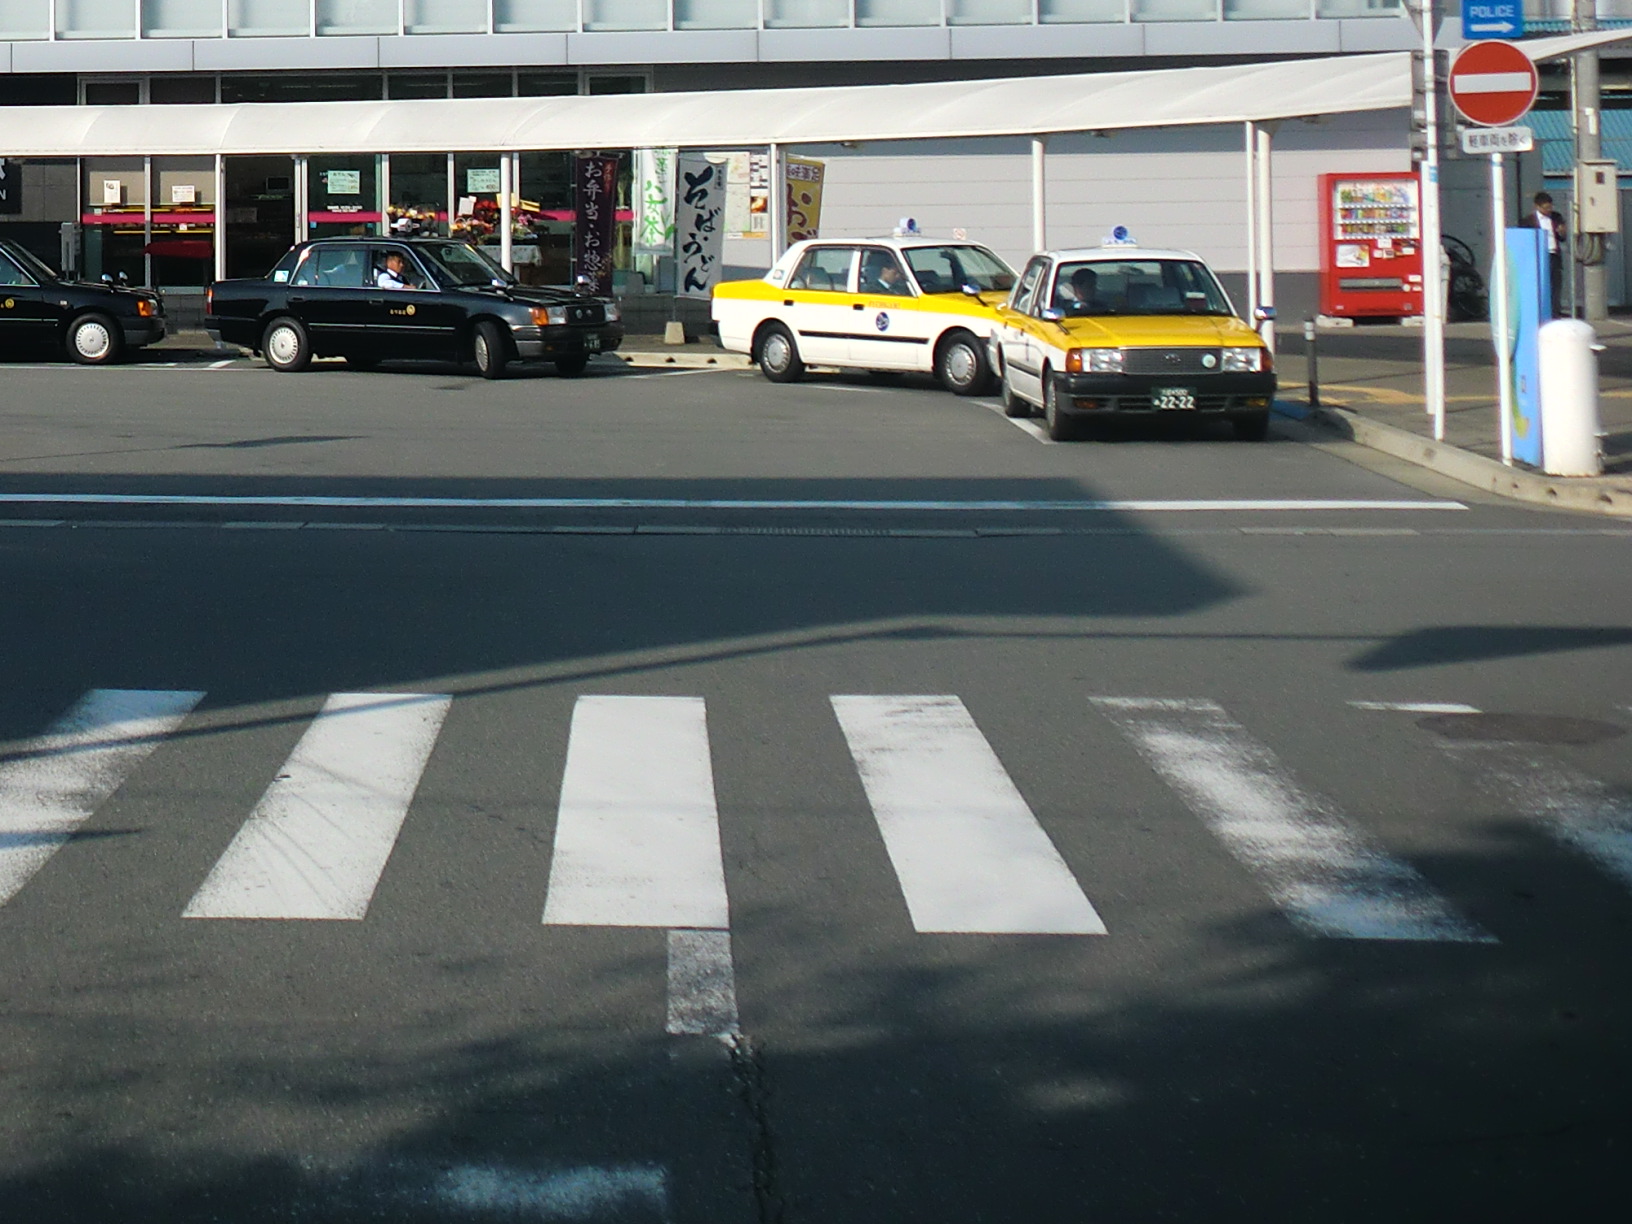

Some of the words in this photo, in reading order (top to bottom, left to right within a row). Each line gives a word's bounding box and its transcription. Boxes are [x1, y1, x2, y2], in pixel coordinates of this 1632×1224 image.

[1469, 5, 1515, 18] POLICE
[681, 165, 722, 293] そば・うどん
[1160, 395, 1196, 410] 22-22
